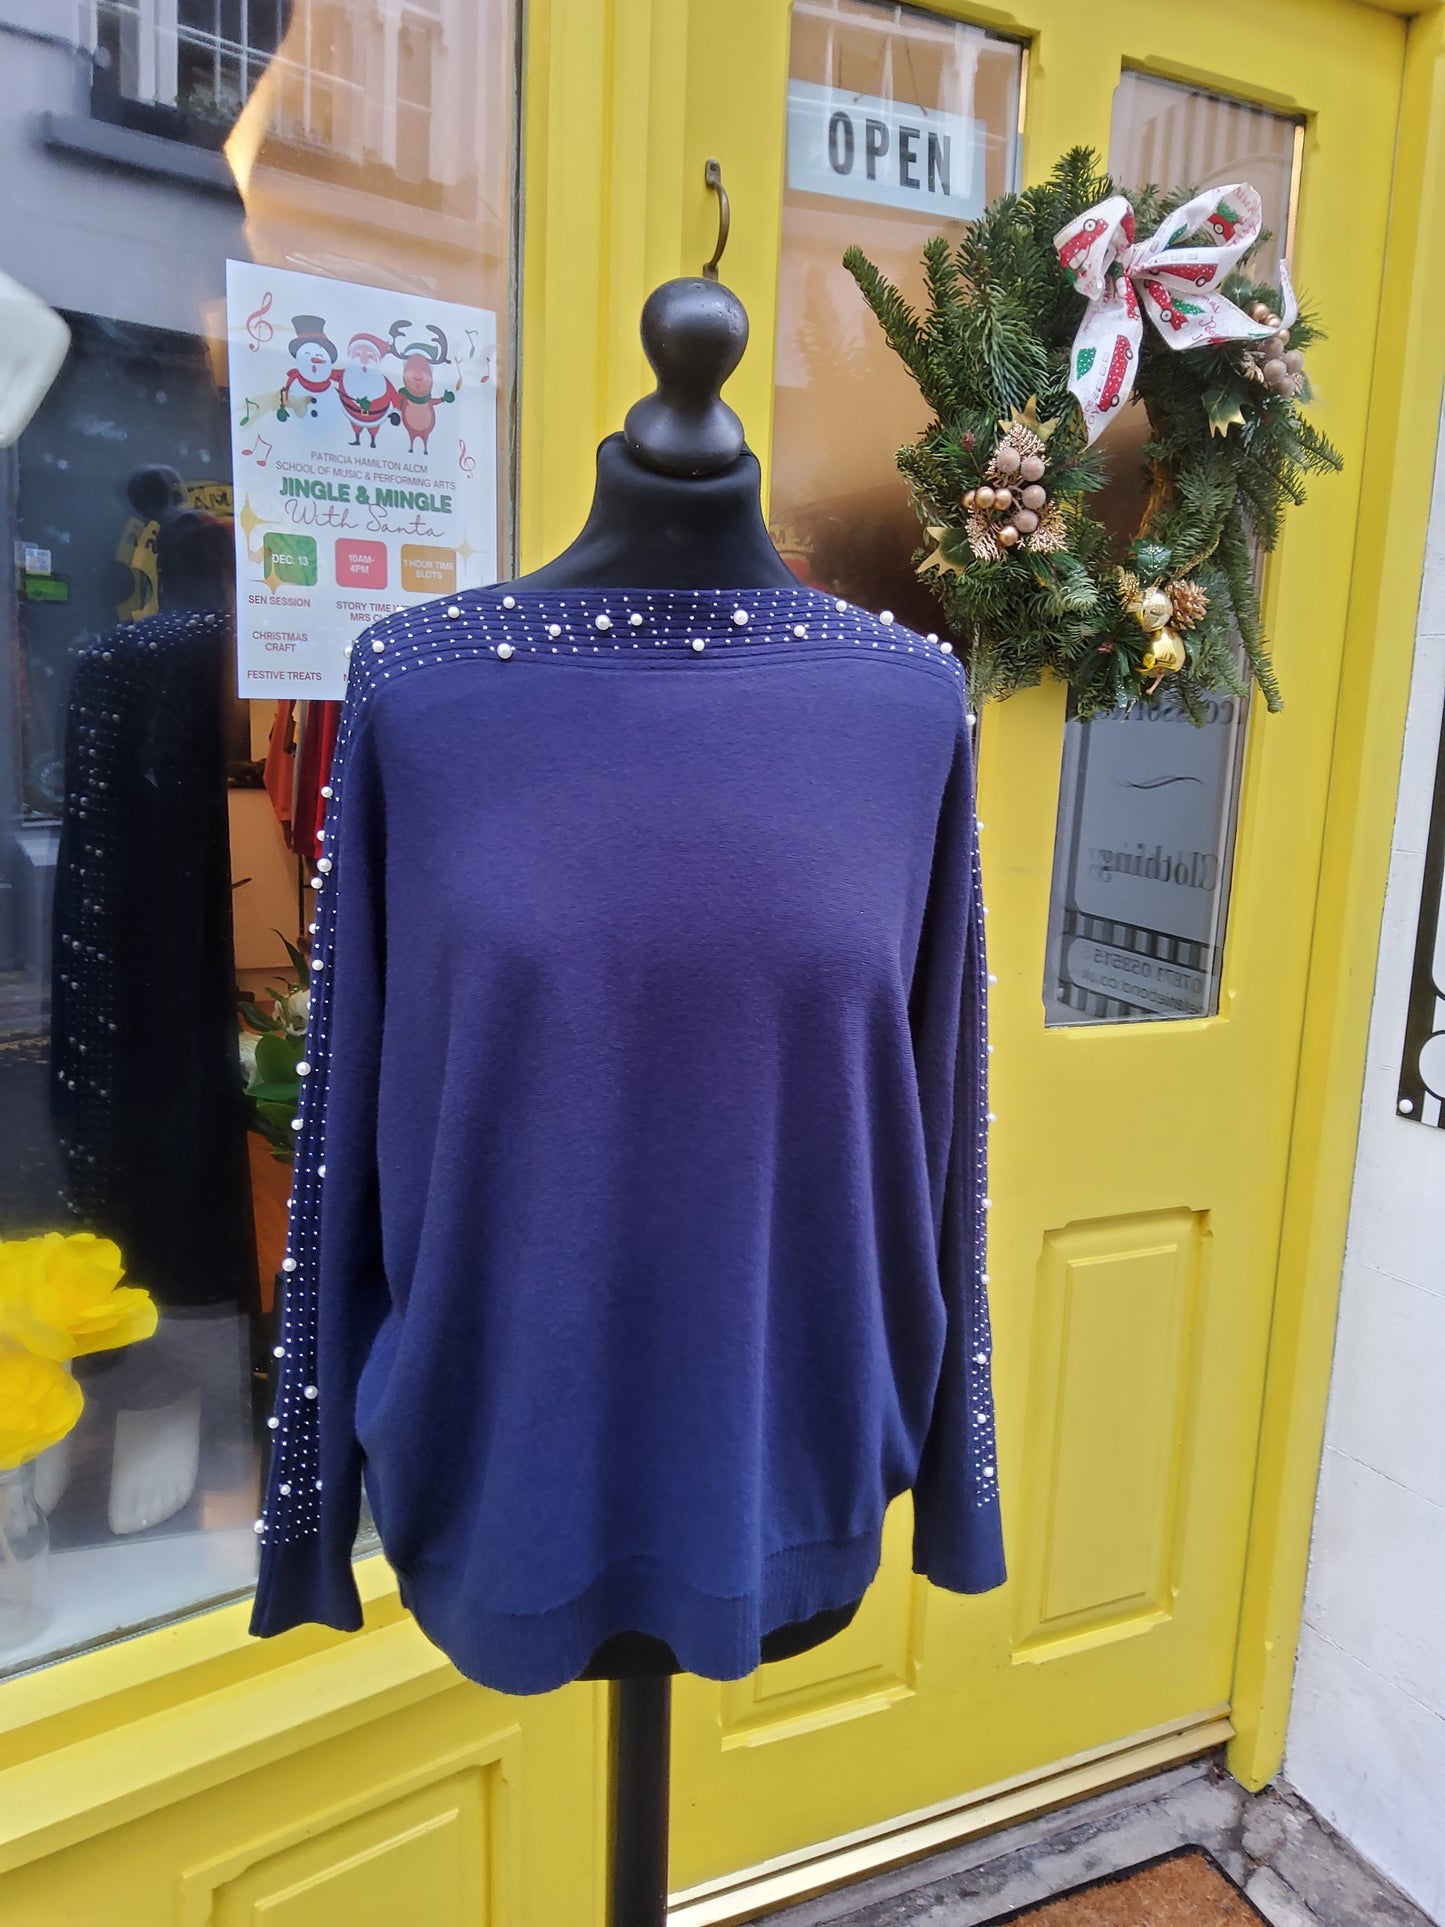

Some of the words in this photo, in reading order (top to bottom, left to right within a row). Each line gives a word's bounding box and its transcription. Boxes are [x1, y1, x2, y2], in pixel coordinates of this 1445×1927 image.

[828, 111, 952, 196] OPEN
[311, 451, 352, 465] PATRICIA
[355, 457, 401, 471] HAMILTON
[403, 463, 428, 474] ALCM
[276, 461, 316, 474] SCHOOL
[318, 466, 330, 475] OF
[333, 468, 362, 480] MUSIC
[365, 471, 371, 481] &
[373, 472, 431, 488] PERFORMING
[433, 480, 456, 491] ARTS
[279, 476, 351, 503] JINGLE
[355, 485, 370, 505] &
[375, 487, 453, 514] MINGLE
[284, 499, 358, 528] With
[366, 503, 445, 537] Santa
[272, 553, 295, 565] DEC.
[297, 556, 309, 566] 13
[348, 554, 375, 564] 10AM-
[409, 559, 433, 570] HOUR
[435, 561, 455, 571] TIME
[350, 564, 369, 574] 4PM
[415, 570, 443, 580] SLOTS
[248, 595, 267, 605] SEN
[269, 597, 311, 608] SESSION
[336, 601, 367, 611] STORY
[370, 603, 391, 613] TIME
[350, 612, 371, 622] MRS
[252, 631, 308, 642] CHRISTMAS
[265, 643, 296, 652] CRAFT
[247, 670, 285, 680] FESTIVE
[287, 671, 322, 681] TREATS
